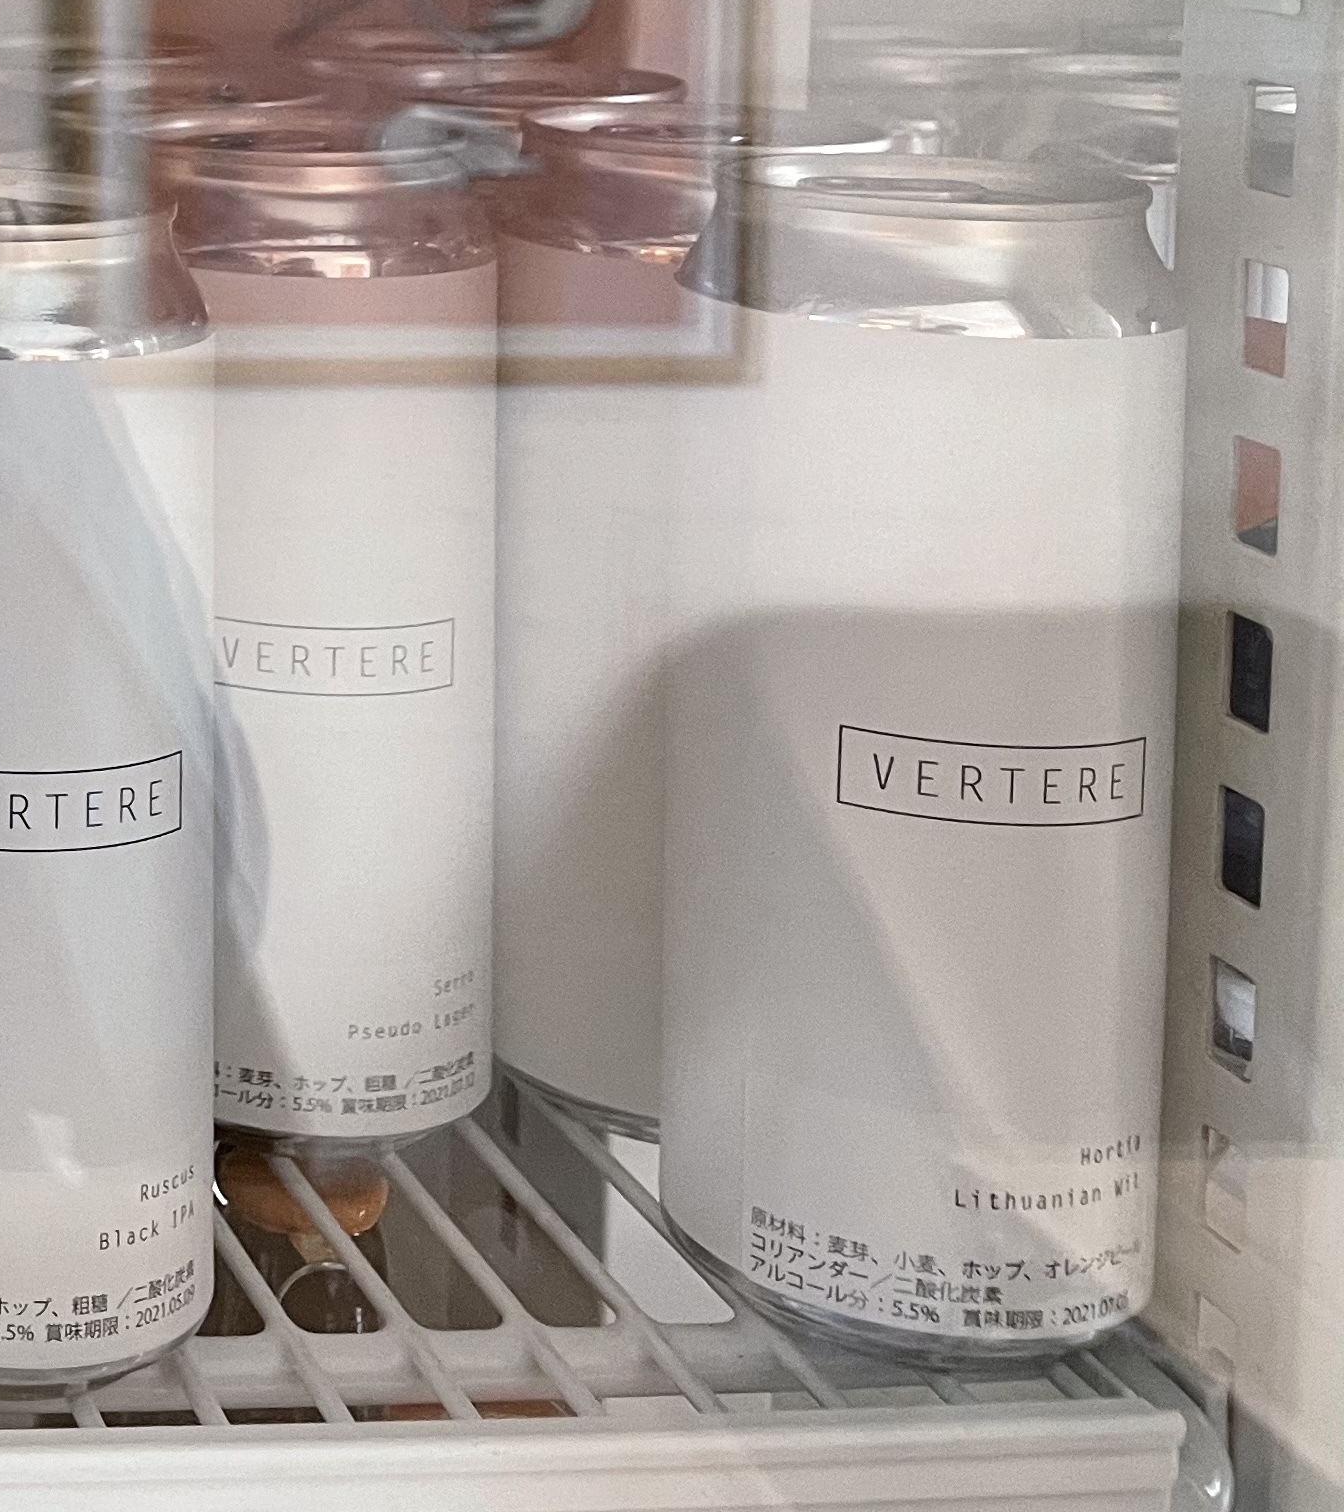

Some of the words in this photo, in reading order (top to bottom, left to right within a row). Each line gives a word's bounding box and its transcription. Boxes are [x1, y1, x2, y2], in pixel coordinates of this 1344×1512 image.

[222, 633, 434, 679] VERTERE
[873, 752, 1125, 805] VERTERE
[348, 1019, 422, 1040] Pseudo
[140, 1164, 195, 1202] Ruscus
[954, 1186, 1102, 1211] Lithuanian
[99, 1219, 160, 1251] Black
[170, 1199, 195, 1230] IPA
